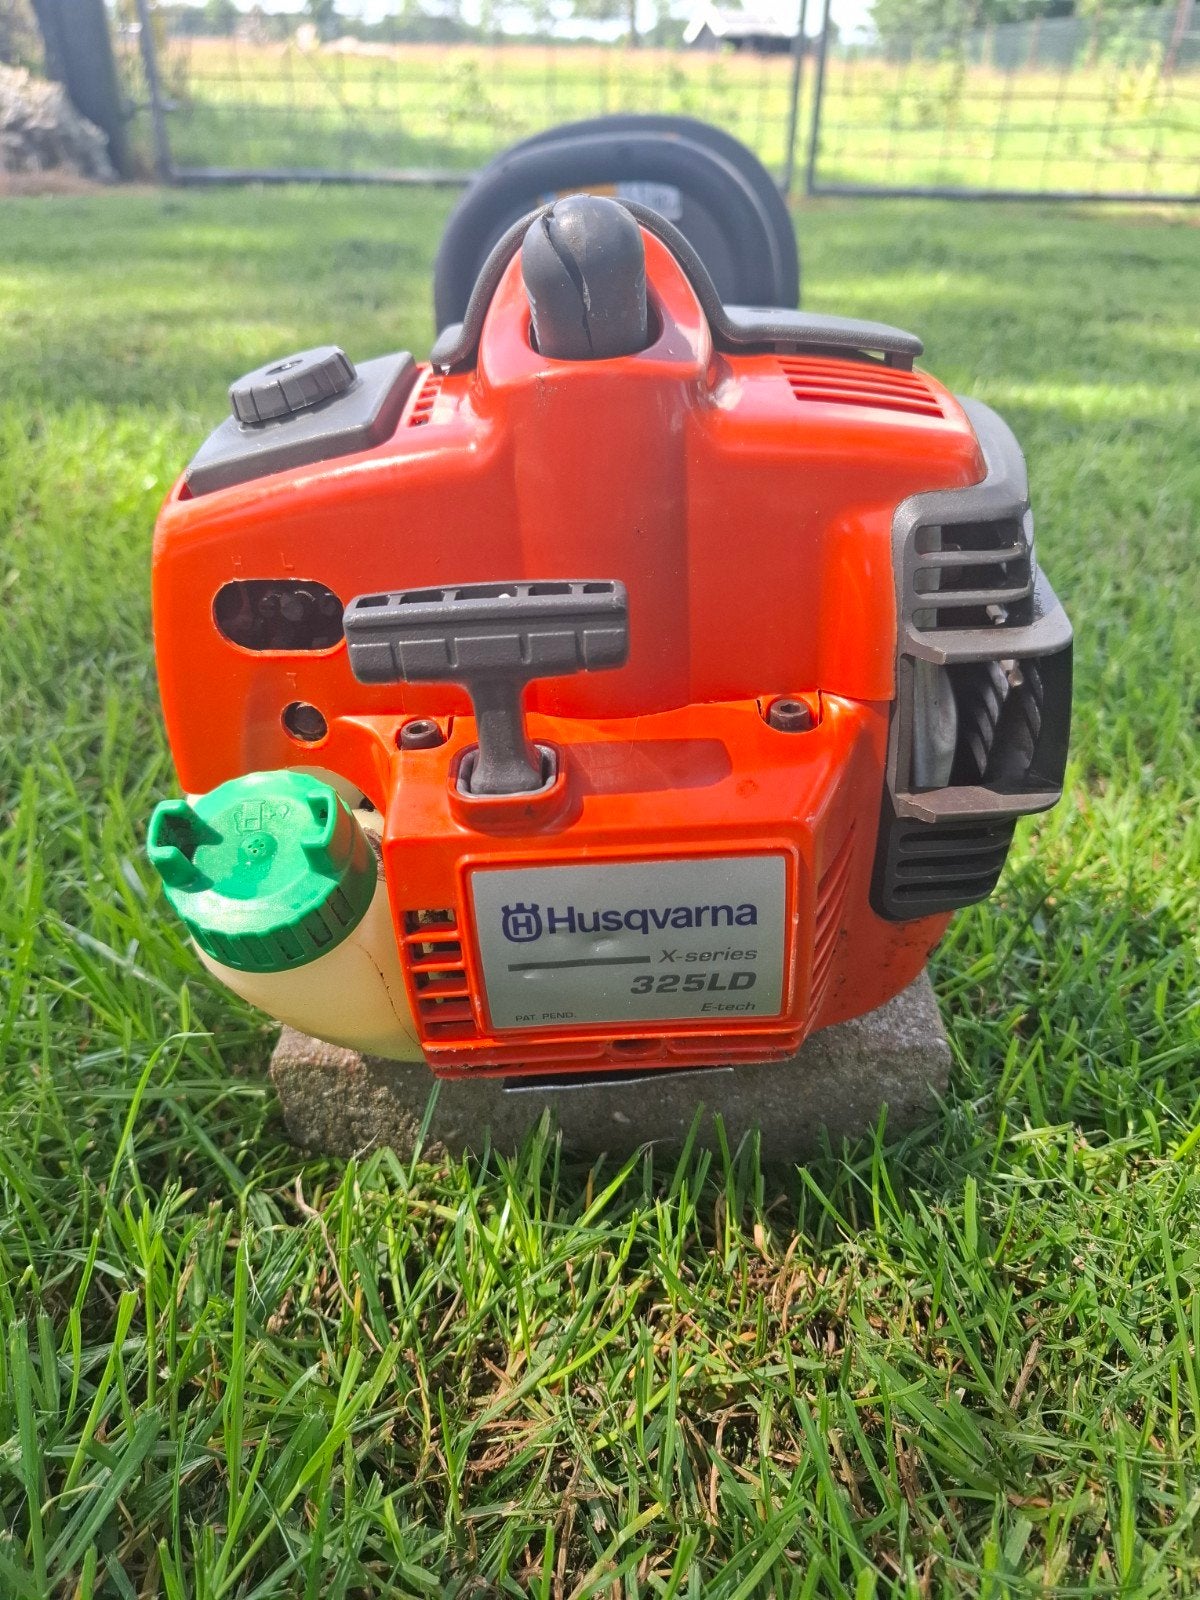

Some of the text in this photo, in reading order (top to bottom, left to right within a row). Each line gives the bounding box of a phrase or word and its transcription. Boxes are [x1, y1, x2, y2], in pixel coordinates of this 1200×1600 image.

[547, 903, 758, 935] Husqvarna
[658, 947, 758, 964] X-series
[630, 971, 757, 995] 325LD
[700, 1001, 756, 1013] E-tech
[515, 1012, 577, 1022] PAT. PEND.
